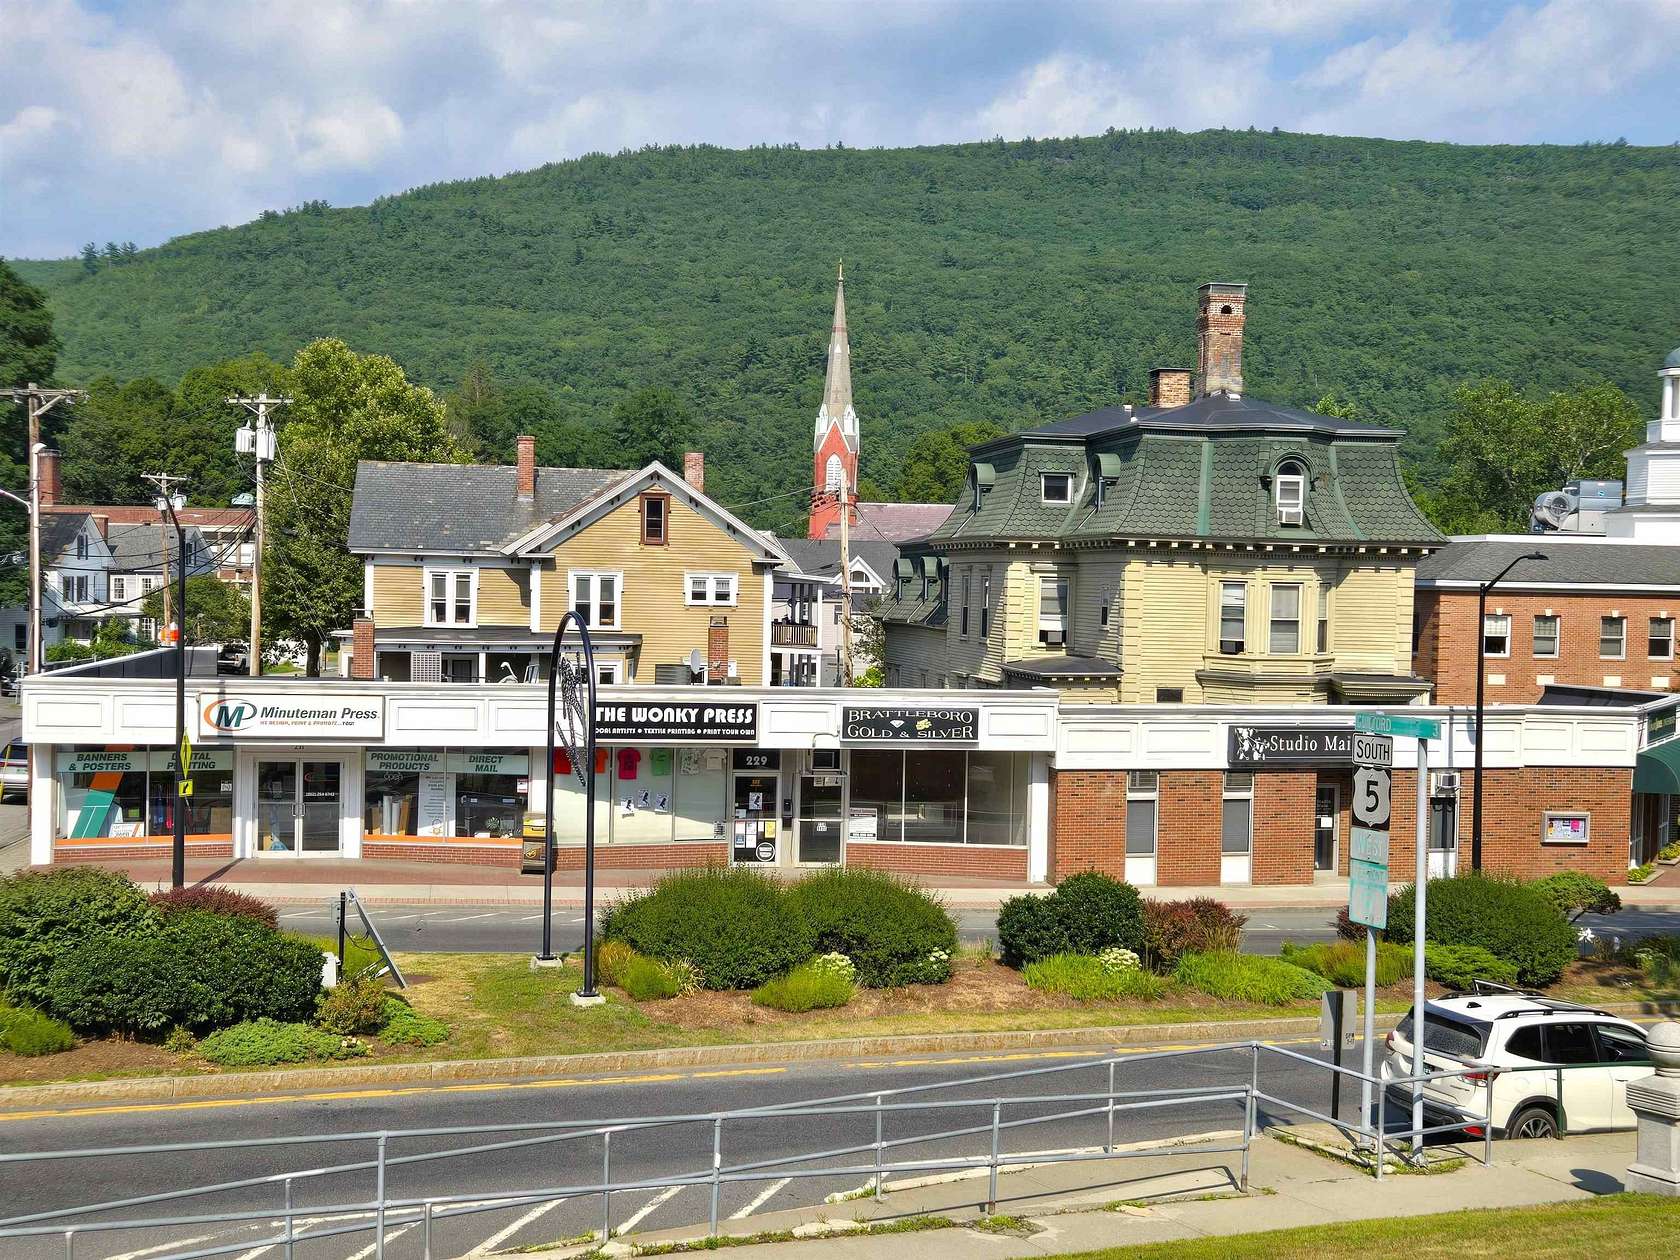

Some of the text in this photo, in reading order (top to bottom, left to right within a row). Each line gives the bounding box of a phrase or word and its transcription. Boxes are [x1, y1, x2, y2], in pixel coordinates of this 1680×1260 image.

[260, 706, 378, 720] Minuteman Press
[596, 706, 753, 724] THE WONKY PRESS
[848, 709, 973, 724] BRATTLEBORO
[847, 725, 893, 738] GOLD
[917, 725, 974, 738] SILVER
[1269, 734, 1351, 752] Studio Mai
[1356, 739, 1390, 761] SOUTH
[76, 753, 128, 761] BANNERS
[171, 752, 211, 761] DTAL
[370, 752, 439, 762] PROMOTIONAL
[469, 755, 504, 764] DIRECT
[746, 756, 768, 766] 229
[69, 762, 132, 771] & POSTERS
[166, 761, 216, 770] PTING
[378, 761, 430, 771] PRODUCTS
[474, 764, 498, 773] MAIL
[1364, 779, 1380, 813] 5
